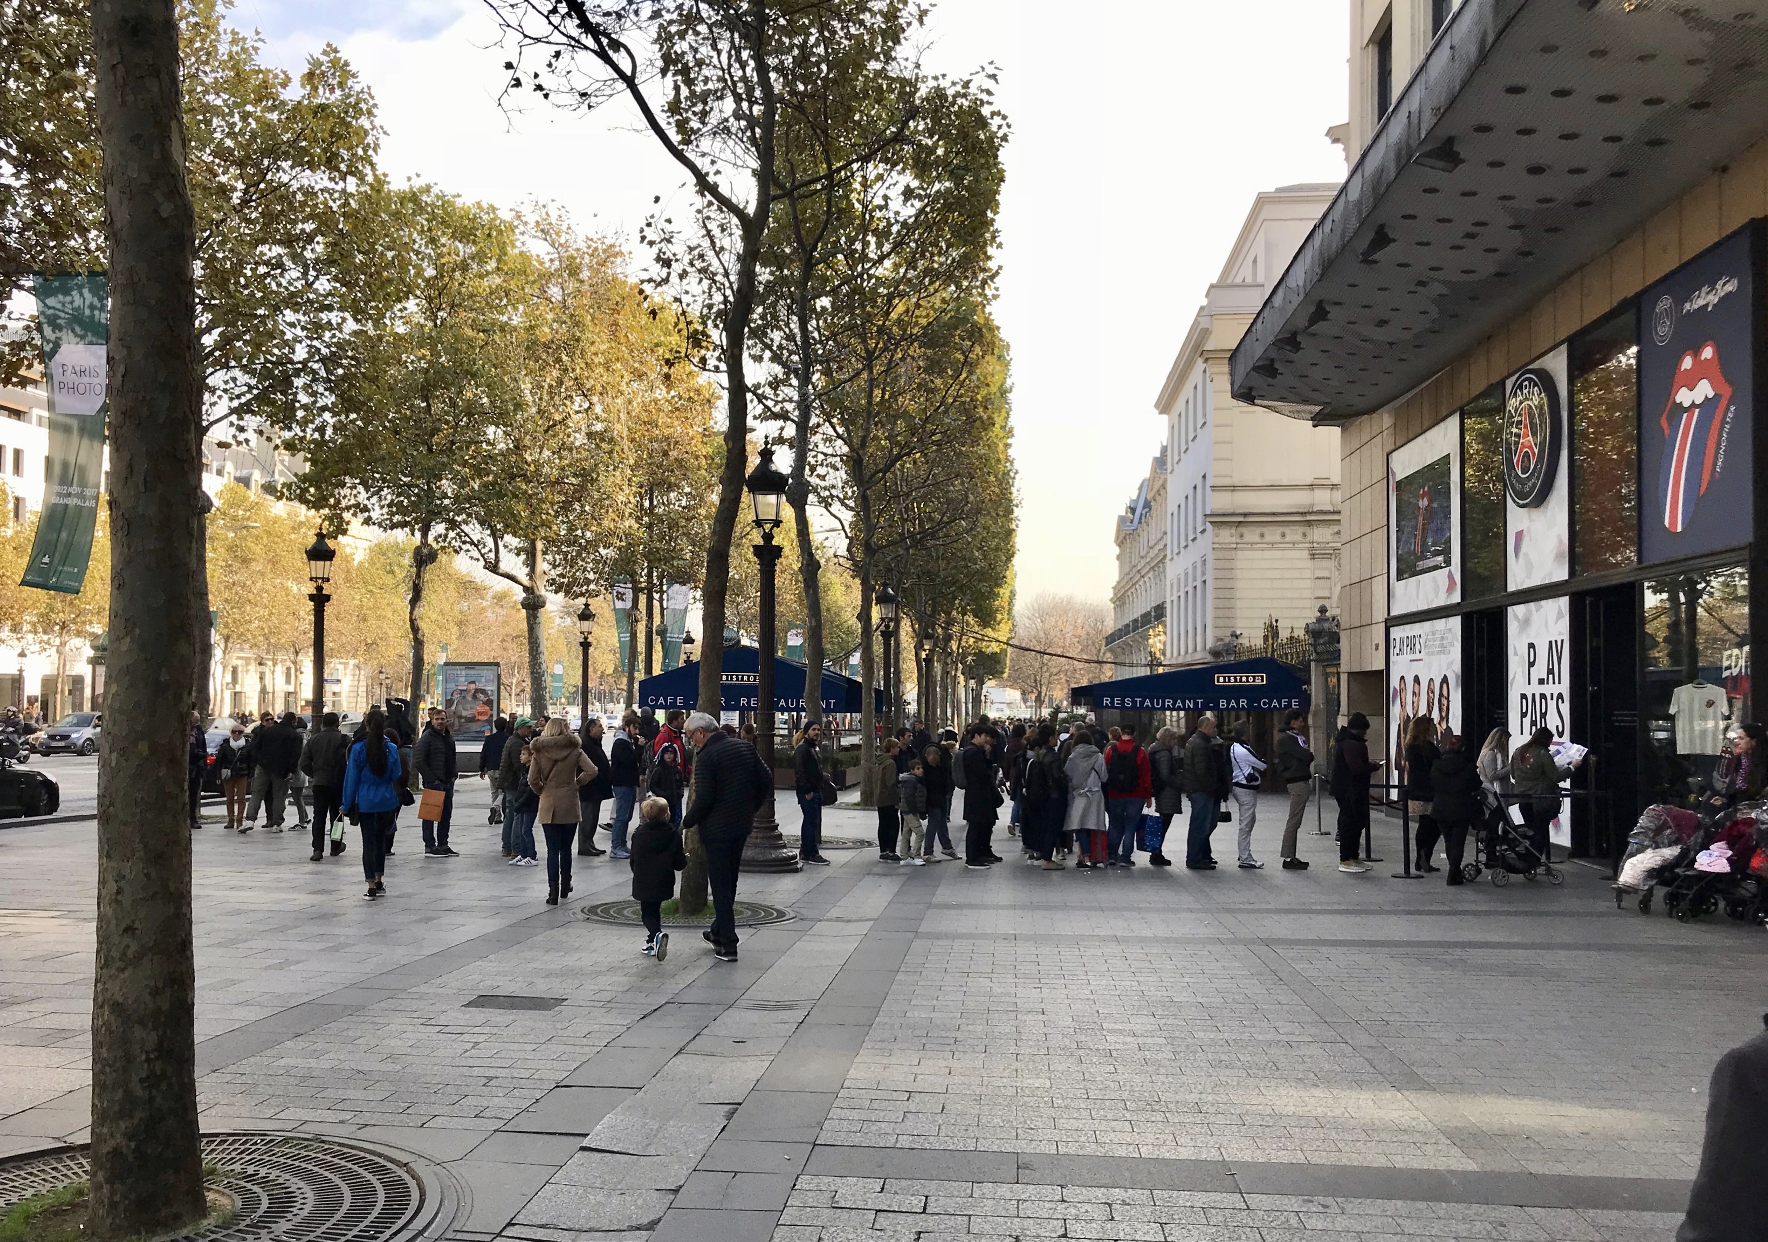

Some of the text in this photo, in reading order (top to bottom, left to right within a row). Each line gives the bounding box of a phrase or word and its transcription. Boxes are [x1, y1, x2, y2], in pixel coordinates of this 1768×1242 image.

[61, 363, 99, 379] PARIS
[58, 381, 103, 396] PHOTO
[1510, 380, 1541, 416] PARIS
[83, 487, 99, 497] 2017
[51, 496, 97, 508] GRAND PALAIS
[721, 674, 755, 682] BISTRO
[1218, 675, 1254, 683] BISTRO
[648, 696, 684, 706] CAFE
[1103, 697, 1204, 709] RESTAURANT
[1219, 699, 1248, 709] BAR
